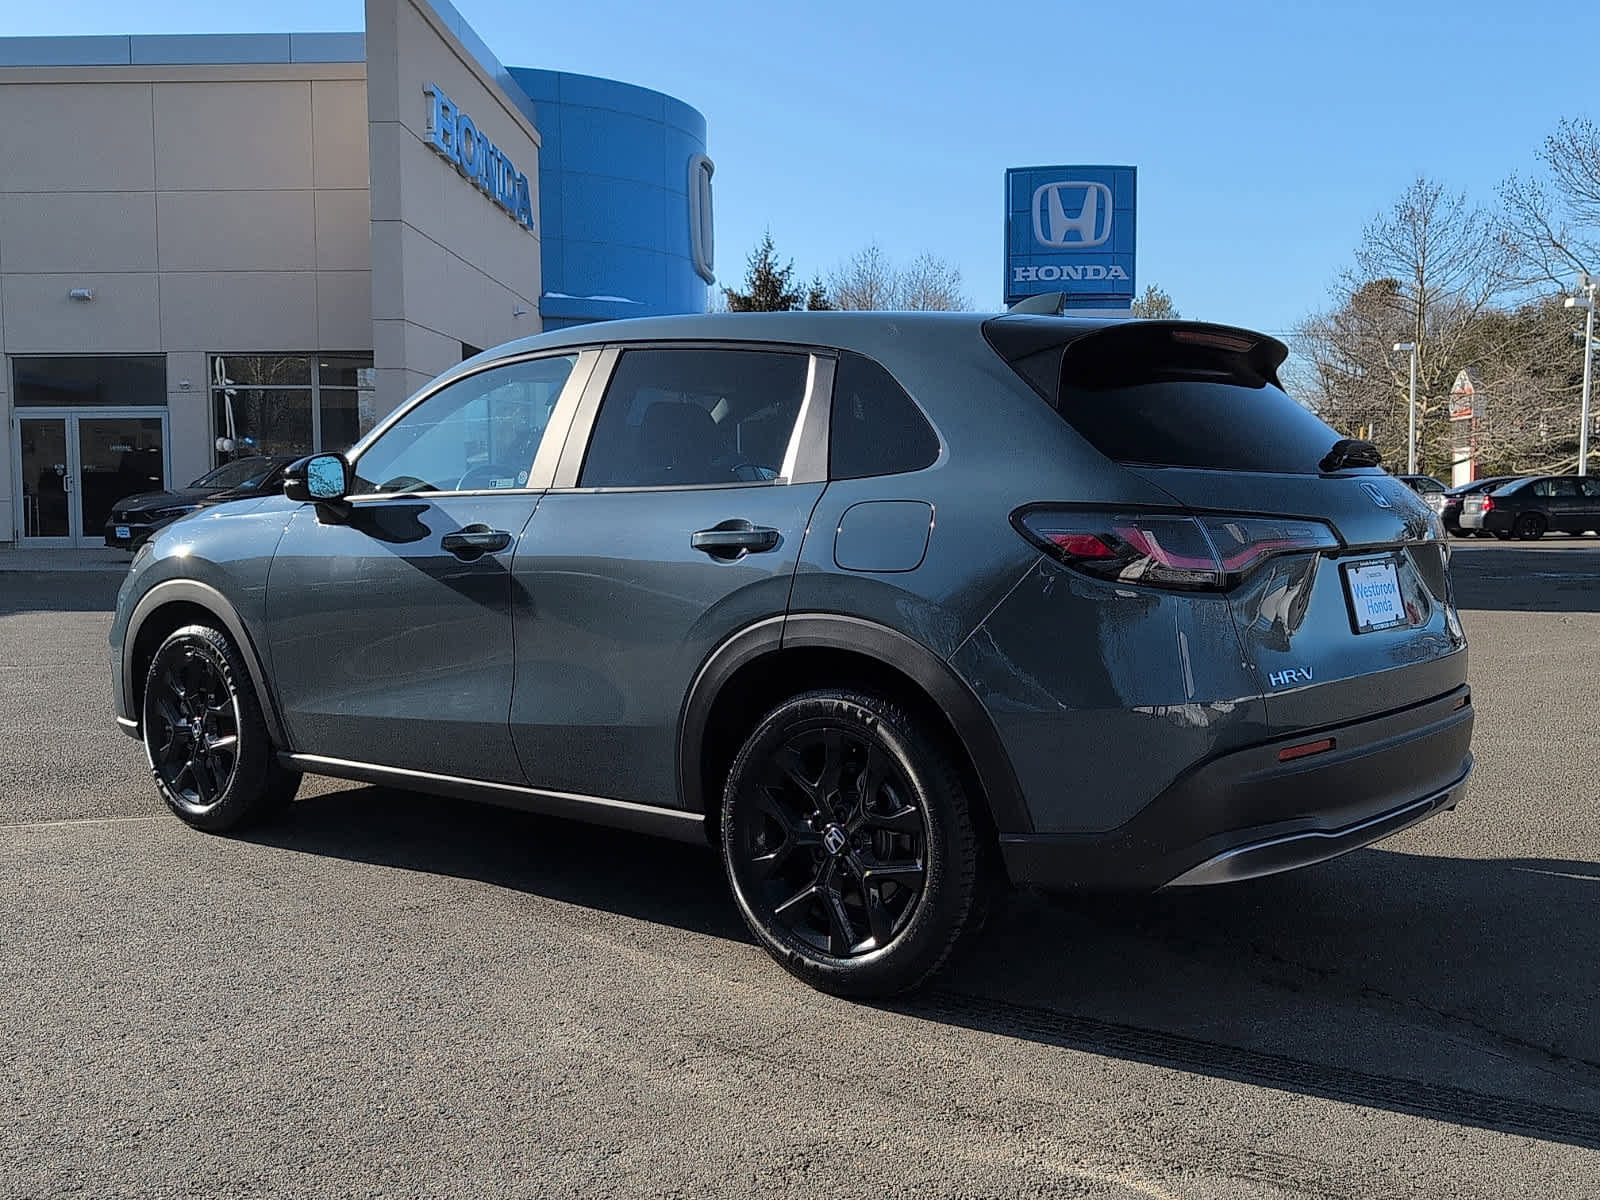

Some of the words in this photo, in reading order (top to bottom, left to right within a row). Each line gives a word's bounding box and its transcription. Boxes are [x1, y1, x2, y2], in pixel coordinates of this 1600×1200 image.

[424, 82, 534, 231] HONDA
[1013, 264, 1129, 282] HONDA
[1353, 579, 1397, 600] Westbrook
[1367, 598, 1393, 615] Honda
[1268, 666, 1313, 686] HR-V
